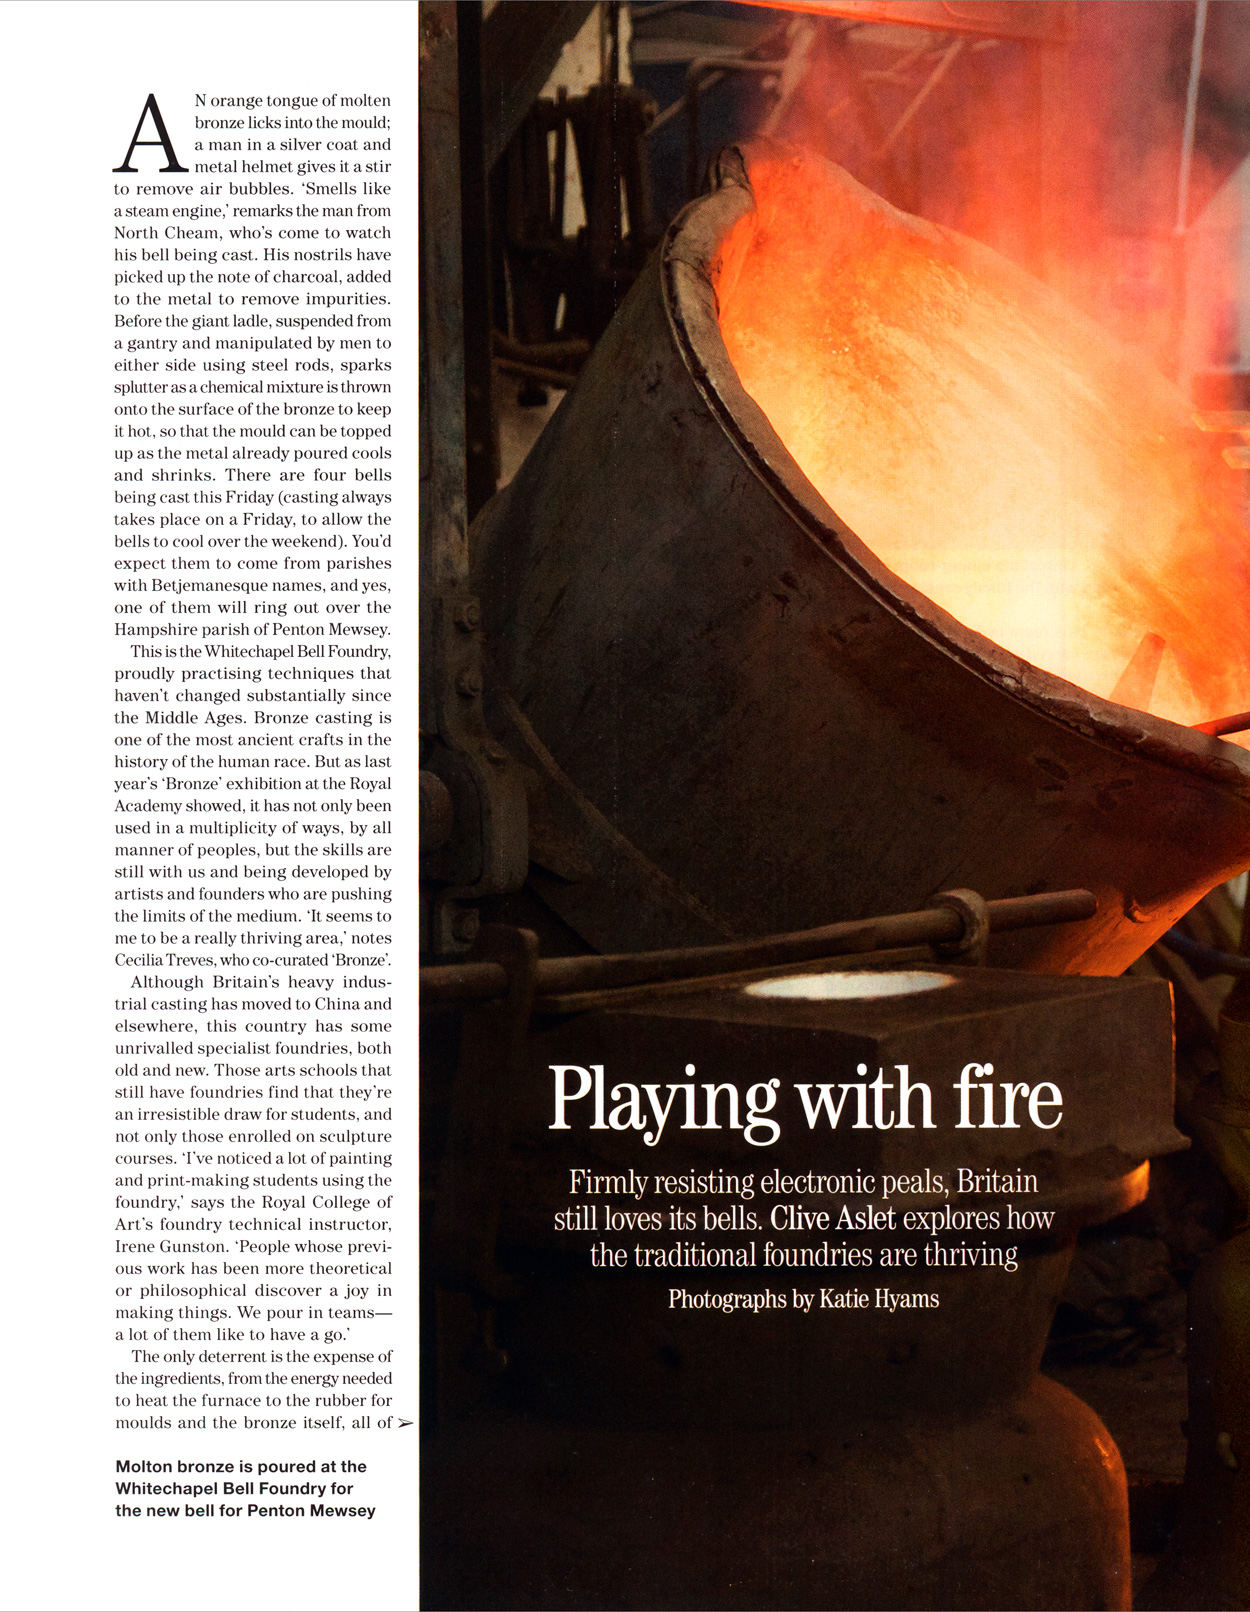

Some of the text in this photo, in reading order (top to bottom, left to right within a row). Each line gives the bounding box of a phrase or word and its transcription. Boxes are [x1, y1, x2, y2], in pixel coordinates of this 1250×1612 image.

[210, 96, 263, 110] orange
[266, 95, 319, 110] tongue
[322, 93, 338, 107] of
[340, 93, 391, 107] molten
[113, 183, 130, 196] to
[136, 185, 194, 196] remove
[200, 182, 223, 195] air
[229, 181, 294, 196] bubbles.
[363, 181, 391, 195] like
[114, 269, 392, 286] picked up the note of charcoal, added
[114, 357, 392, 375] either side using steel rods, sparks
[114, 446, 392, 463] up as the metal already poured cools
[114, 534, 150, 548] bells
[153, 536, 169, 548] to
[172, 534, 204, 548] cool
[207, 538, 241, 548] over
[244, 534, 268, 548] the
[271, 534, 348, 550] weekend).
[114, 622, 391, 639] Hampshire parish of Penton Mewsey.
[114, 710, 392, 728] the Middle Ages. Bronze casting is
[114, 798, 392, 815] Academy showed, it has not only been
[114, 886, 392, 904] artists and founders who are pushing
[131, 975, 204, 992] Although
[288, 975, 335, 992] heavy
[343, 975, 392, 989] indus-
[115, 1063, 391, 1077] old and new. Those arts schools that
[115, 1155, 177, 1165] courses.
[217, 1151, 272, 1165] noticed
[275, 1155, 284, 1165] a
[288, 1151, 306, 1165] lot
[310, 1151, 327, 1165] of
[329, 1151, 393, 1168] painting
[115, 1239, 155, 1253] Irene
[159, 1239, 229, 1253] Gunston.
[294, 1239, 343, 1253] whose
[348, 1239, 392, 1256] previ-
[115, 1331, 124, 1341] a
[129, 1327, 147, 1341] lot
[153, 1327, 170, 1341] of
[173, 1327, 212, 1341] them
[217, 1327, 245, 1341] like
[249, 1329, 265, 1341] to
[270, 1327, 306, 1341] have
[310, 1331, 319, 1341] a
[116, 1415, 394, 1431] moulds and the bronze itself, all of
